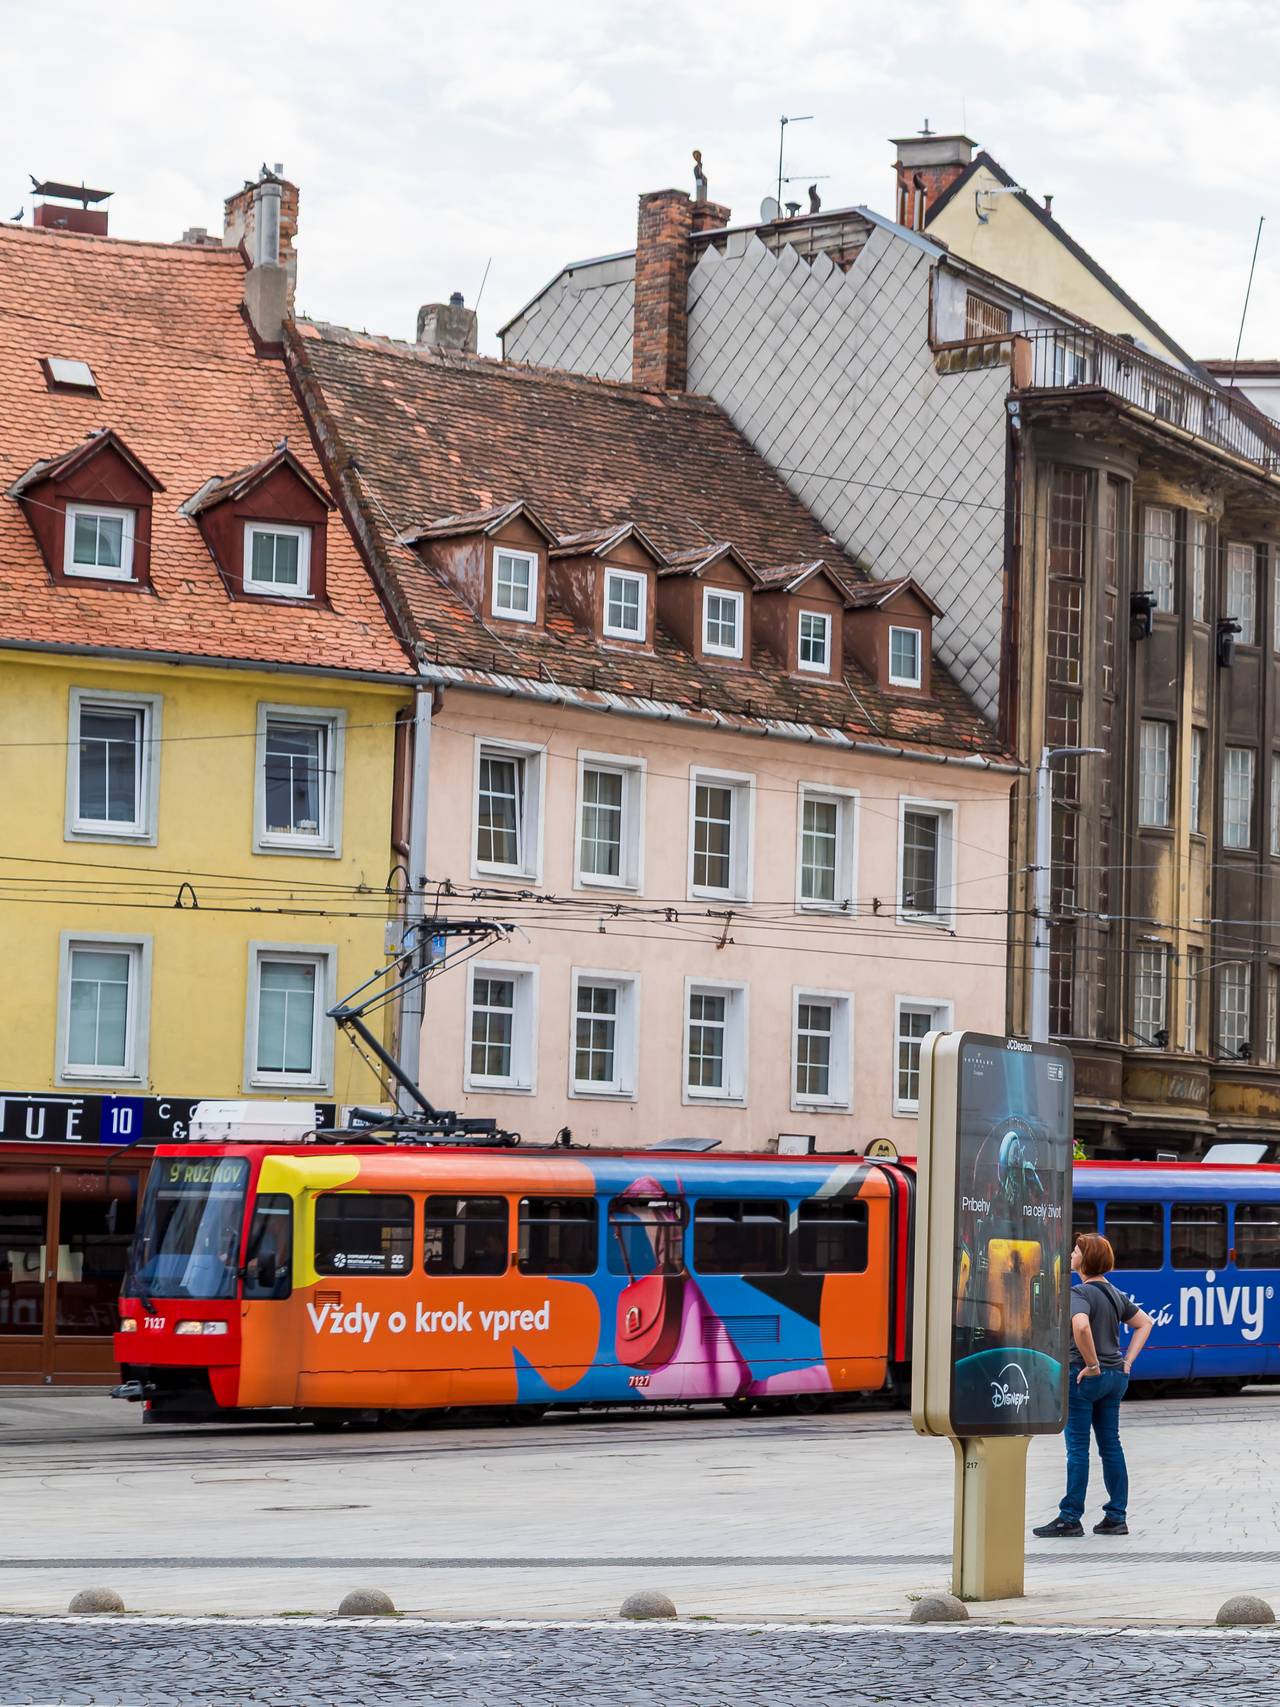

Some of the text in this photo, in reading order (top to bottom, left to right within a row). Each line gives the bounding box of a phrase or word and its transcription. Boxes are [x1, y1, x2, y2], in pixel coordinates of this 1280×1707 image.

[1006, 1040, 1033, 1053] JCDecaux
[111, 1107, 132, 1134] 10
[170, 1163, 180, 1183] 9
[144, 1317, 166, 1329] 7127
[306, 1300, 550, 1343] Vždy o krok vpred
[629, 1375, 650, 1387] 7127
